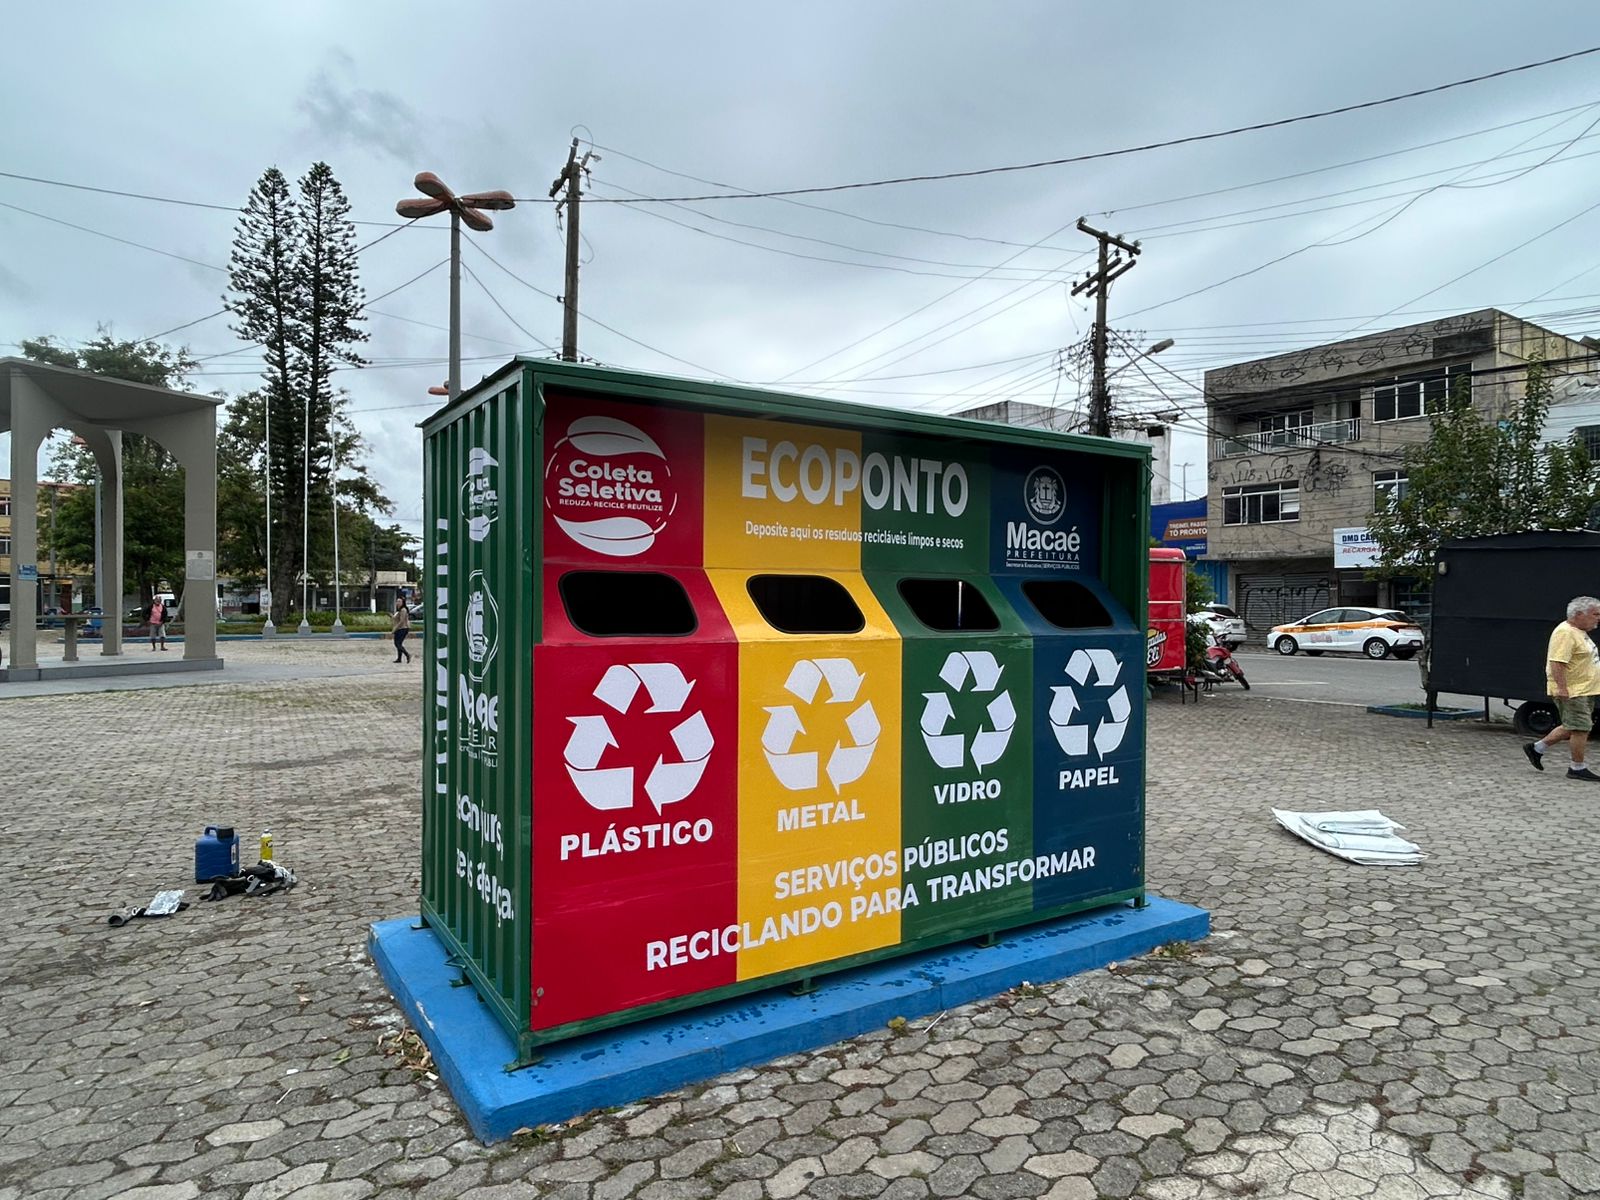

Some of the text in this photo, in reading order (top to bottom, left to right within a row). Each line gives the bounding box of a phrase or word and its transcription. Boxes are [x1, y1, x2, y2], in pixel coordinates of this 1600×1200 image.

[569, 459, 653, 484] Coleta
[742, 436, 969, 518] ECOPONTO
[558, 477, 662, 502] Seletiva
[559, 498, 663, 512] REDUZA RECICLE REUTILIZE
[745, 520, 788, 539] Deposite
[790, 524, 811, 541] aqui
[812, 528, 823, 539] os
[864, 529, 907, 545] recicláveis
[908, 532, 934, 549] limpos
[935, 537, 941, 547] e
[942, 538, 964, 549] secos
[1006, 521, 1080, 552] Macaé
[1180, 528, 1207, 536] PRONTO
[1342, 534, 1359, 542] DMD
[1006, 550, 1079, 560] PREFEITURA
[1059, 766, 1119, 790] PAPEL
[933, 779, 1001, 805] VIDRO
[777, 799, 865, 832] METAL
[560, 818, 713, 861] PLÁSTICO
[775, 828, 1009, 890] SERVIÇOS PÚBLICOS
[646, 846, 1096, 971] RECICLANDO PARA TRANSFORMAR
